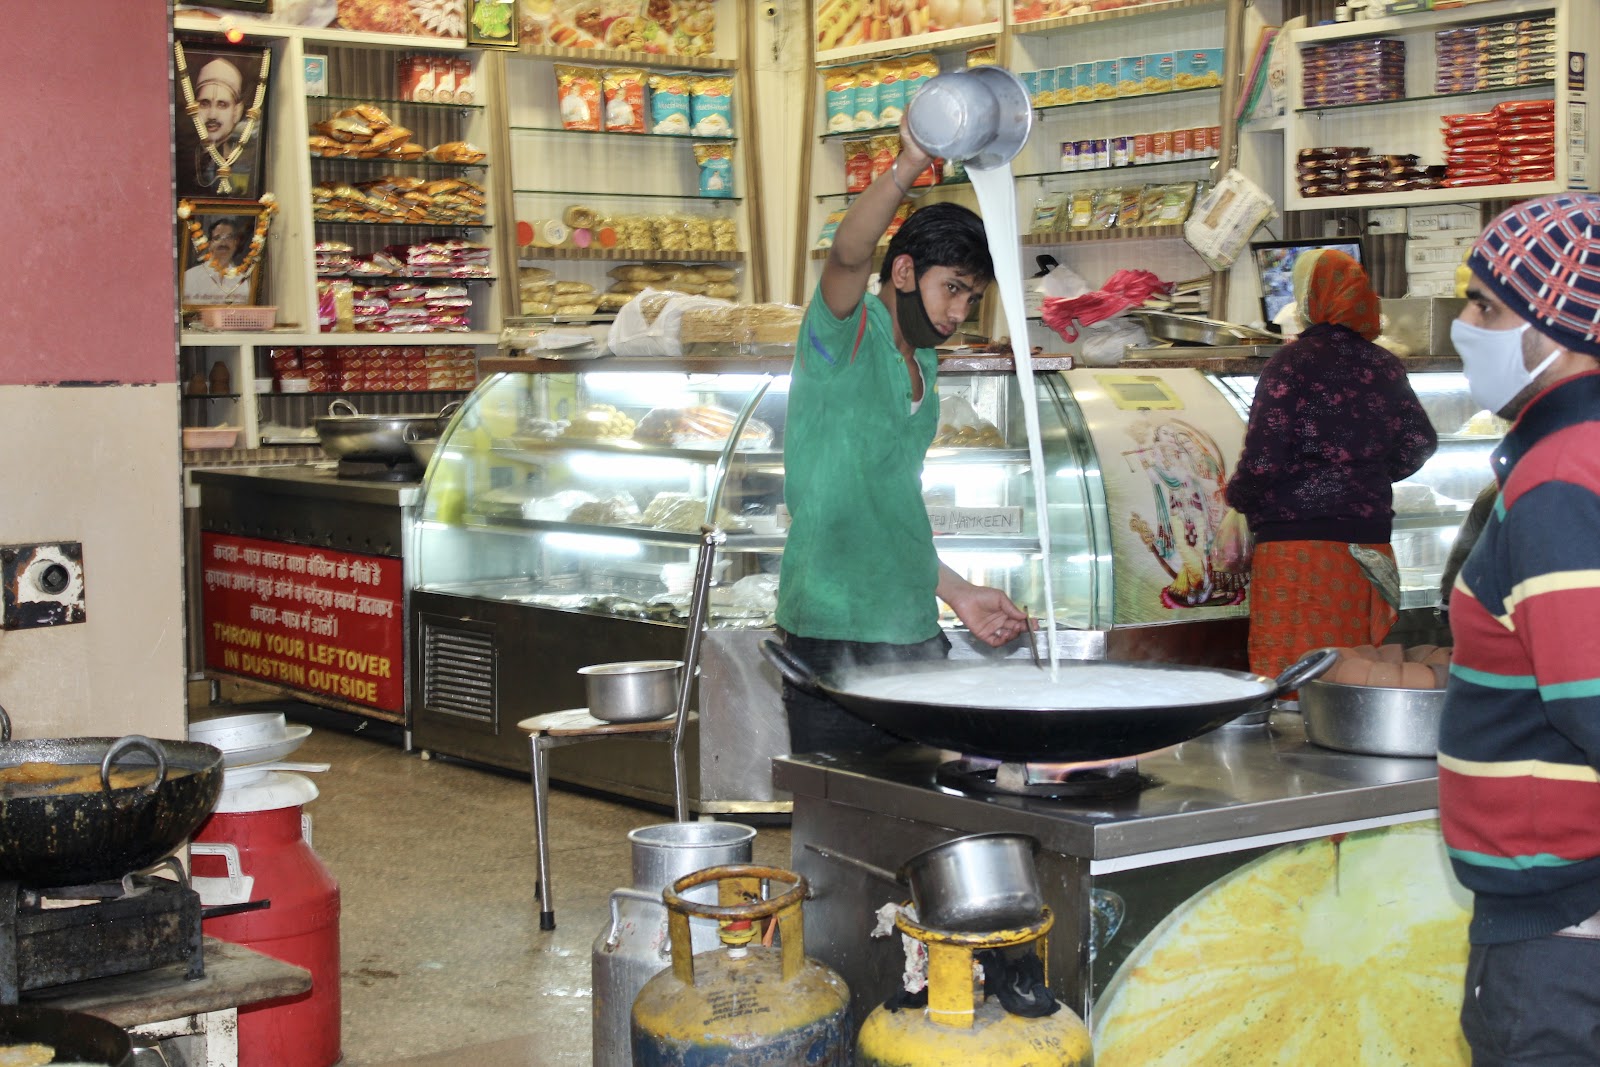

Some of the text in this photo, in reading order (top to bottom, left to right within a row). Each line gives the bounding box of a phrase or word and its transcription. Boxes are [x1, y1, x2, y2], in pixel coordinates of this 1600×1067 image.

[949, 511, 1012, 530] NAMKEEN
[205, 569, 231, 591] कृपया
[232, 570, 256, 593] अपने
[262, 551, 286, 570] बाहर
[337, 557, 349, 580] के
[371, 562, 382, 586] है
[301, 610, 312, 632] में
[214, 623, 391, 679] THROW YOUR LEFTOVER
[225, 650, 377, 702] IN DUSTBIN OUTSIDE
